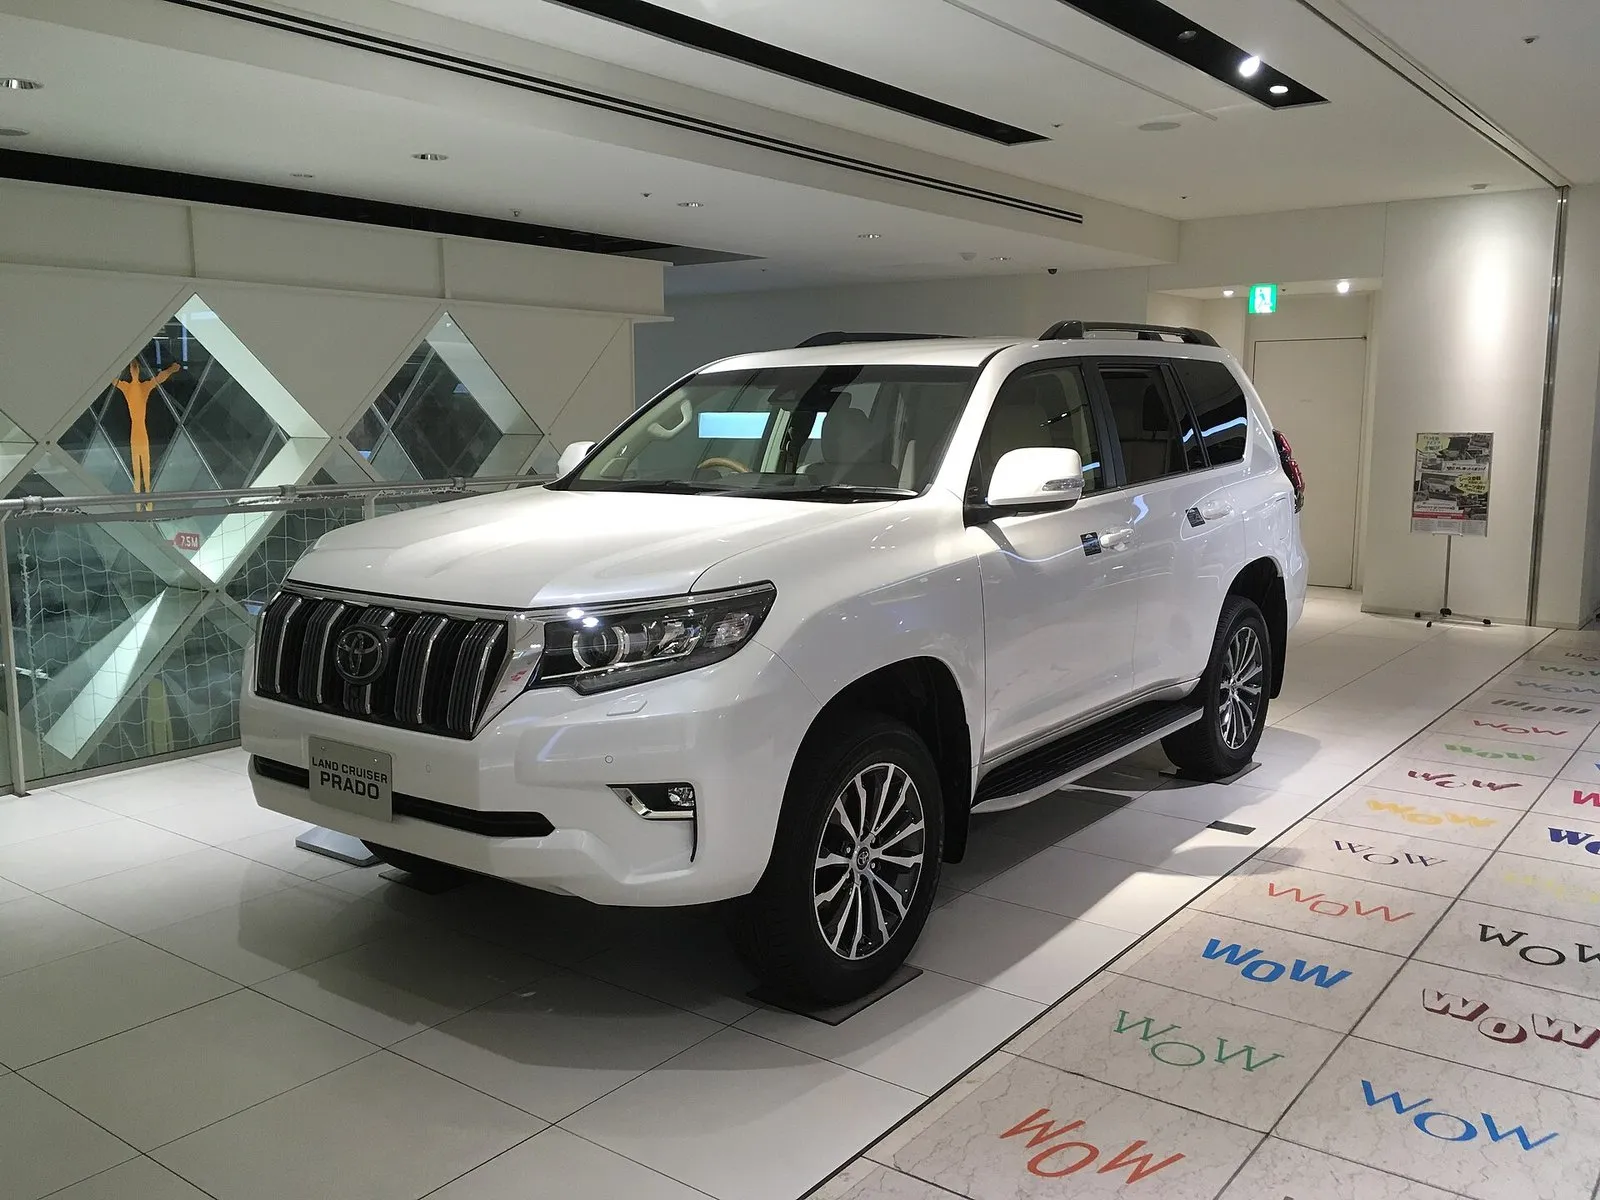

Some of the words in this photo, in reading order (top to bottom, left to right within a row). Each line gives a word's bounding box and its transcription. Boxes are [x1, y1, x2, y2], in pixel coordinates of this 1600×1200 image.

[1473, 720, 1568, 736] WOW
[311, 756, 339, 771] LAND
[341, 763, 388, 784] CRUISER
[320, 770, 379, 800] PRADO
[1407, 770, 1523, 791] WOW
[1366, 799, 1497, 828] WOW
[1333, 839, 1448, 867] WOW
[1267, 882, 1415, 922] WOW
[1201, 938, 1353, 990] WOW
[1422, 988, 1600, 1050] WOW
[1113, 1010, 1285, 1072] WOW
[1361, 1079, 1559, 1151] WOW
[1000, 1108, 1187, 1184] WOW
